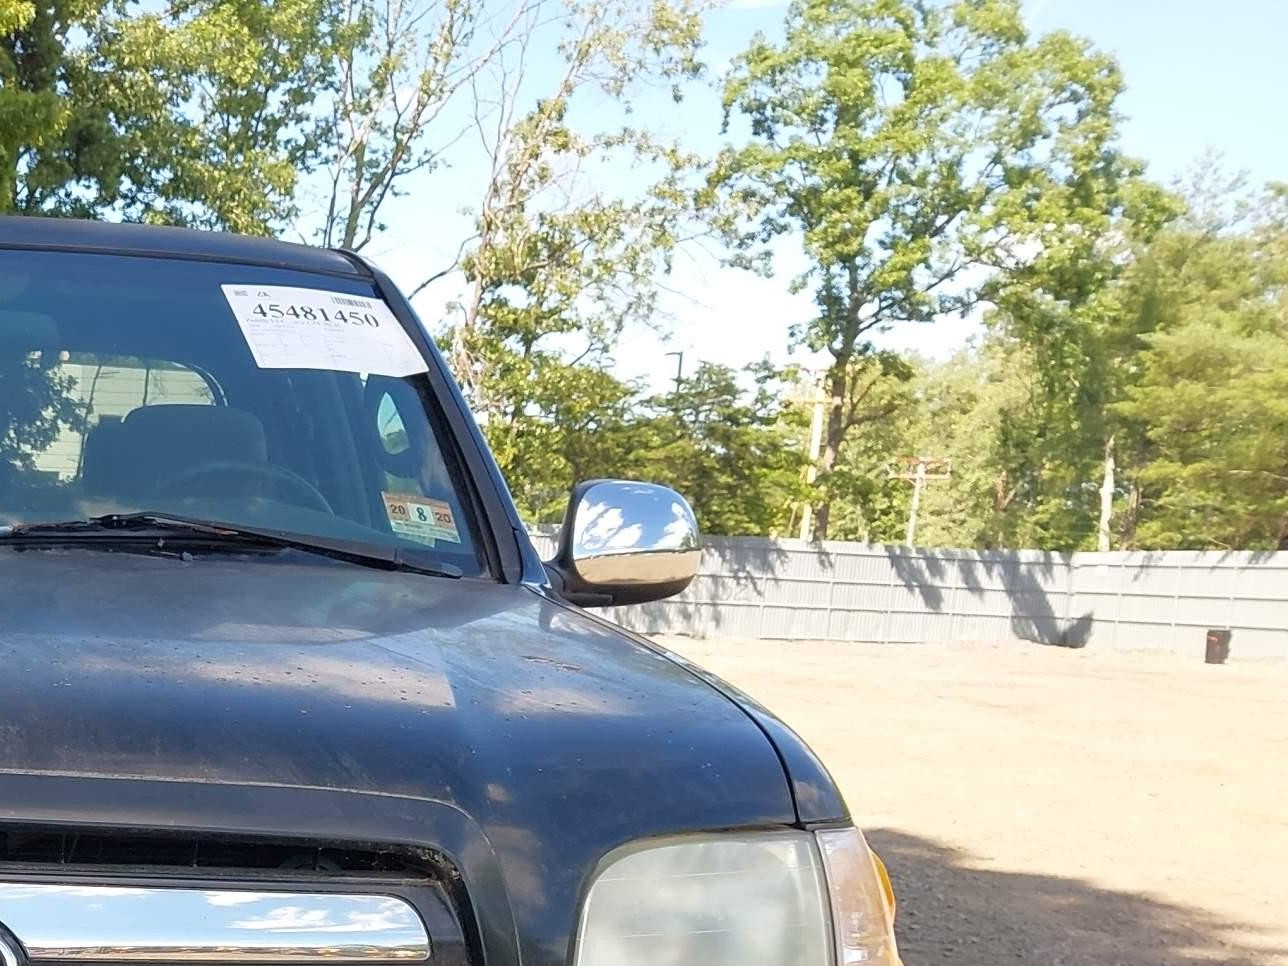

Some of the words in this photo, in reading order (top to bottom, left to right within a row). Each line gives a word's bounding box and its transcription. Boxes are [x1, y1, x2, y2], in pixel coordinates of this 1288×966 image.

[253, 303, 379, 328] 45481450
[390, 503, 406, 515] 20
[416, 506, 427, 522] 8
[435, 512, 451, 523] 20
